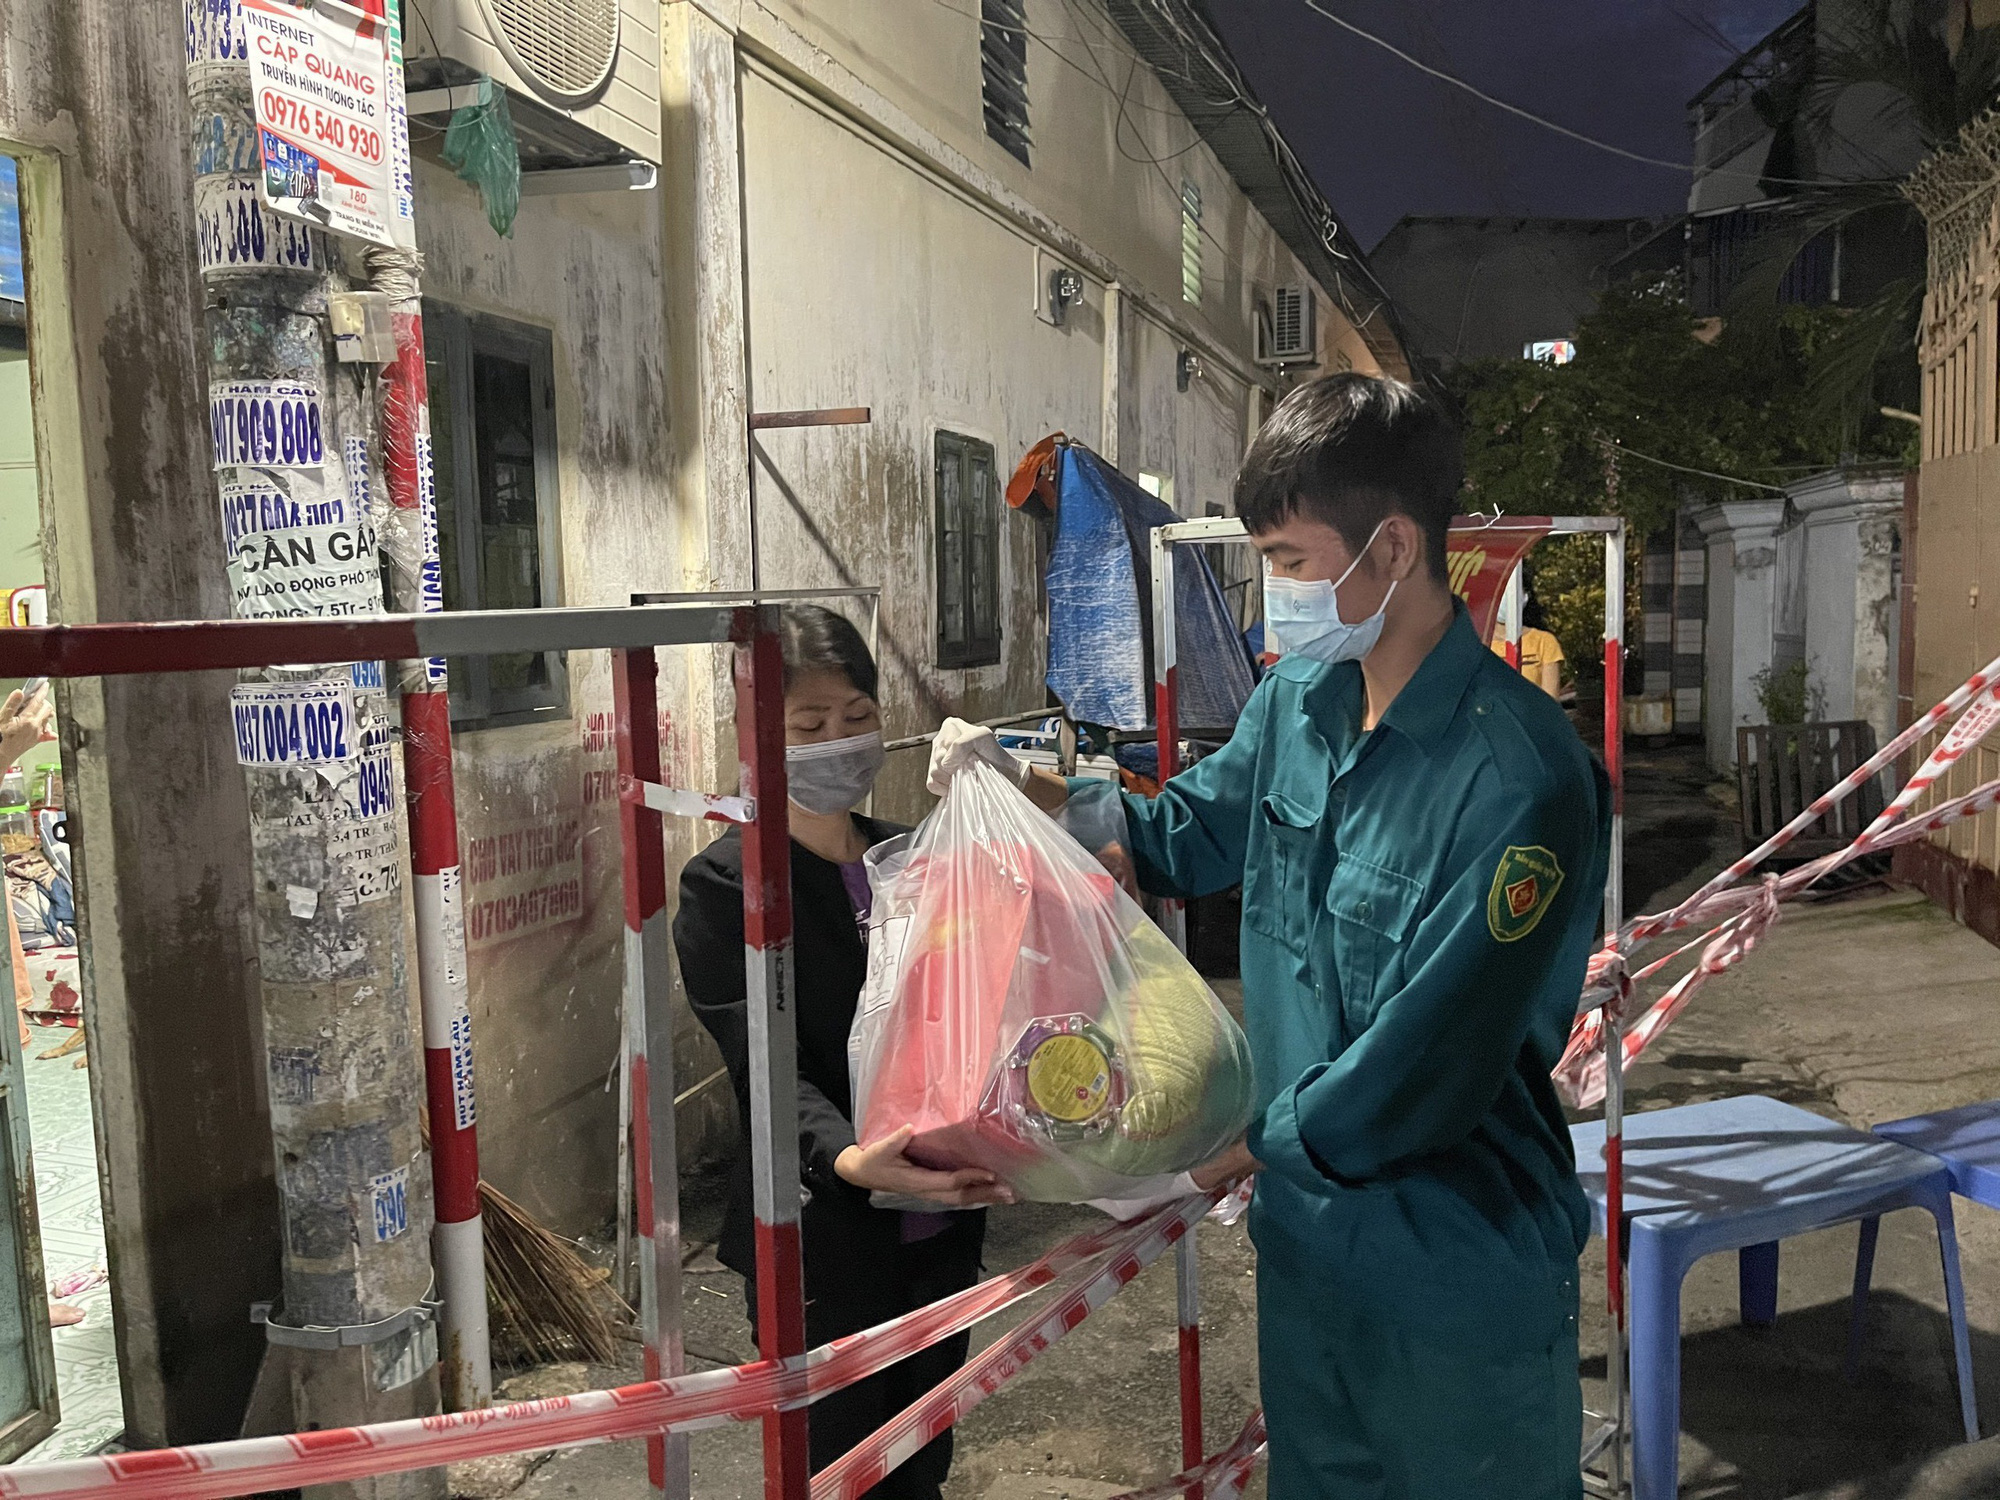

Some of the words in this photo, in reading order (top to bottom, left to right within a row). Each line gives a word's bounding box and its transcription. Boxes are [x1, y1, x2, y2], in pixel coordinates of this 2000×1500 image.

[247, 10, 315, 47] INTERNET
[257, 34, 298, 64] CÁP
[305, 53, 375, 95] QUANG
[299, 74, 323, 98] HÌNH
[357, 97, 375, 118] TÁC
[264, 91, 310, 135] 0976
[315, 109, 344, 149] 540
[348, 124, 380, 161] 930
[350, 188, 367, 204] 180
[239, 535, 316, 573] CẦN
[328, 523, 376, 562] GẤP
[255, 582, 286, 596] LAO
[290, 576, 336, 593] ĐỘNG
